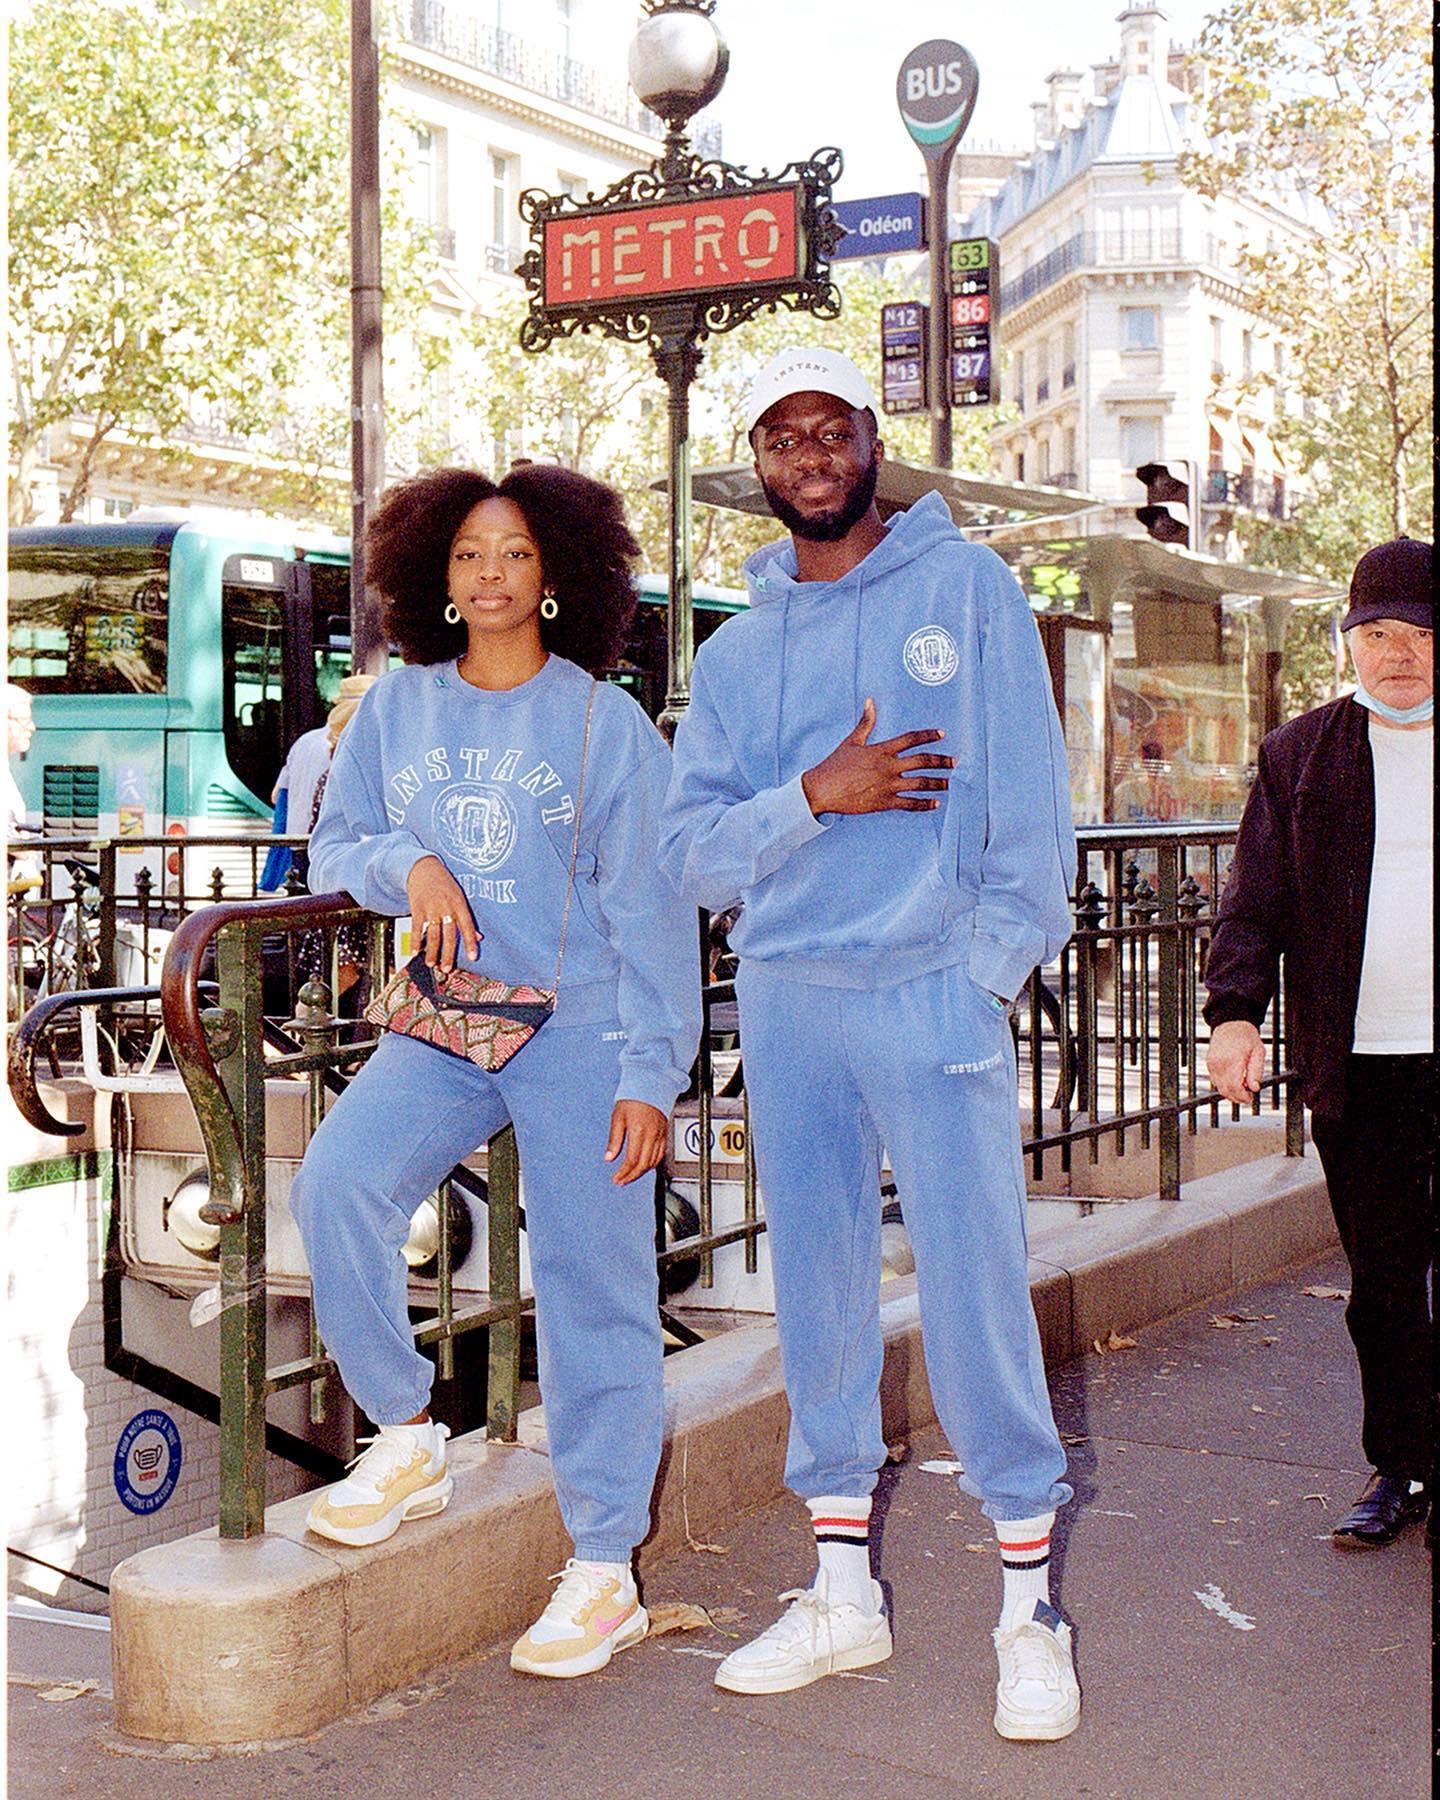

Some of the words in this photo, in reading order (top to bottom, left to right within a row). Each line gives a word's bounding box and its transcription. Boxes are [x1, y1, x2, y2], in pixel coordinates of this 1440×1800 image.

[906, 61, 962, 101] BUS
[860, 215, 913, 237] Odéon
[562, 208, 780, 291] METRO
[957, 244, 984, 267] 63
[884, 308, 917, 327] N12
[956, 298, 985, 323] 86
[885, 362, 918, 381] N13
[957, 353, 985, 378] 87
[386, 747, 576, 826] INSTANT
[458, 873, 518, 904] UNK
[722, 1130, 745, 1151] 10
